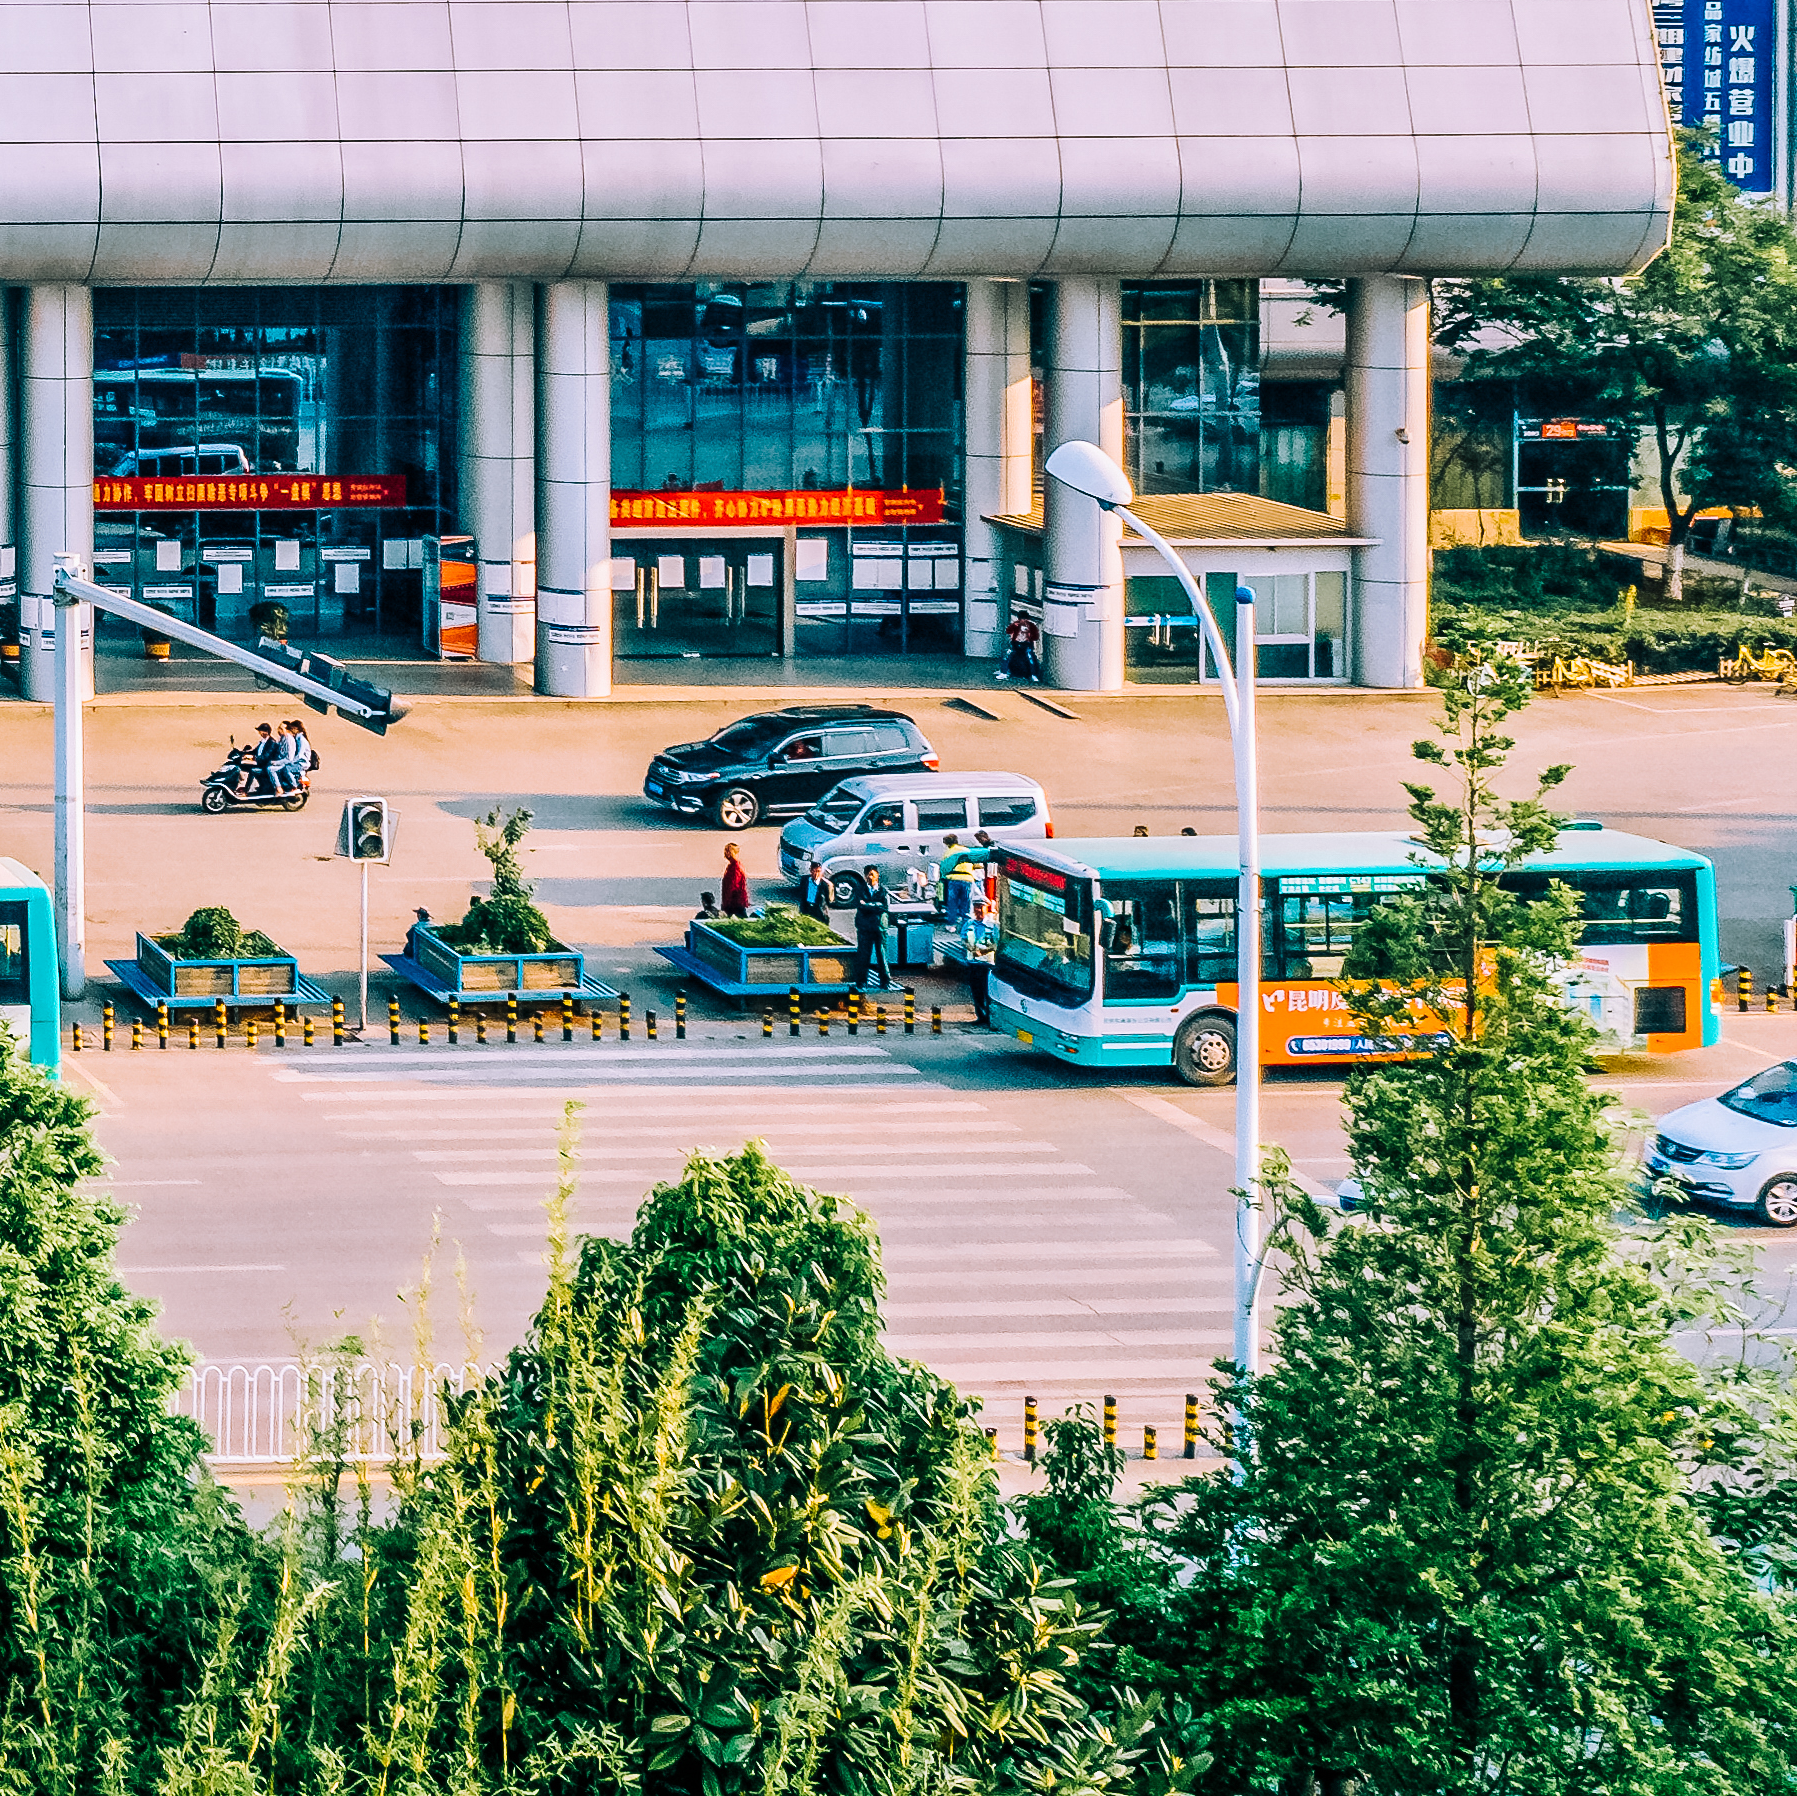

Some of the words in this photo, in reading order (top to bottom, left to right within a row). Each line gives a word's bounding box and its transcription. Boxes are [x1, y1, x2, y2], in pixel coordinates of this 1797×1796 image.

[1728, 25, 1755, 179] 火爆营业中
